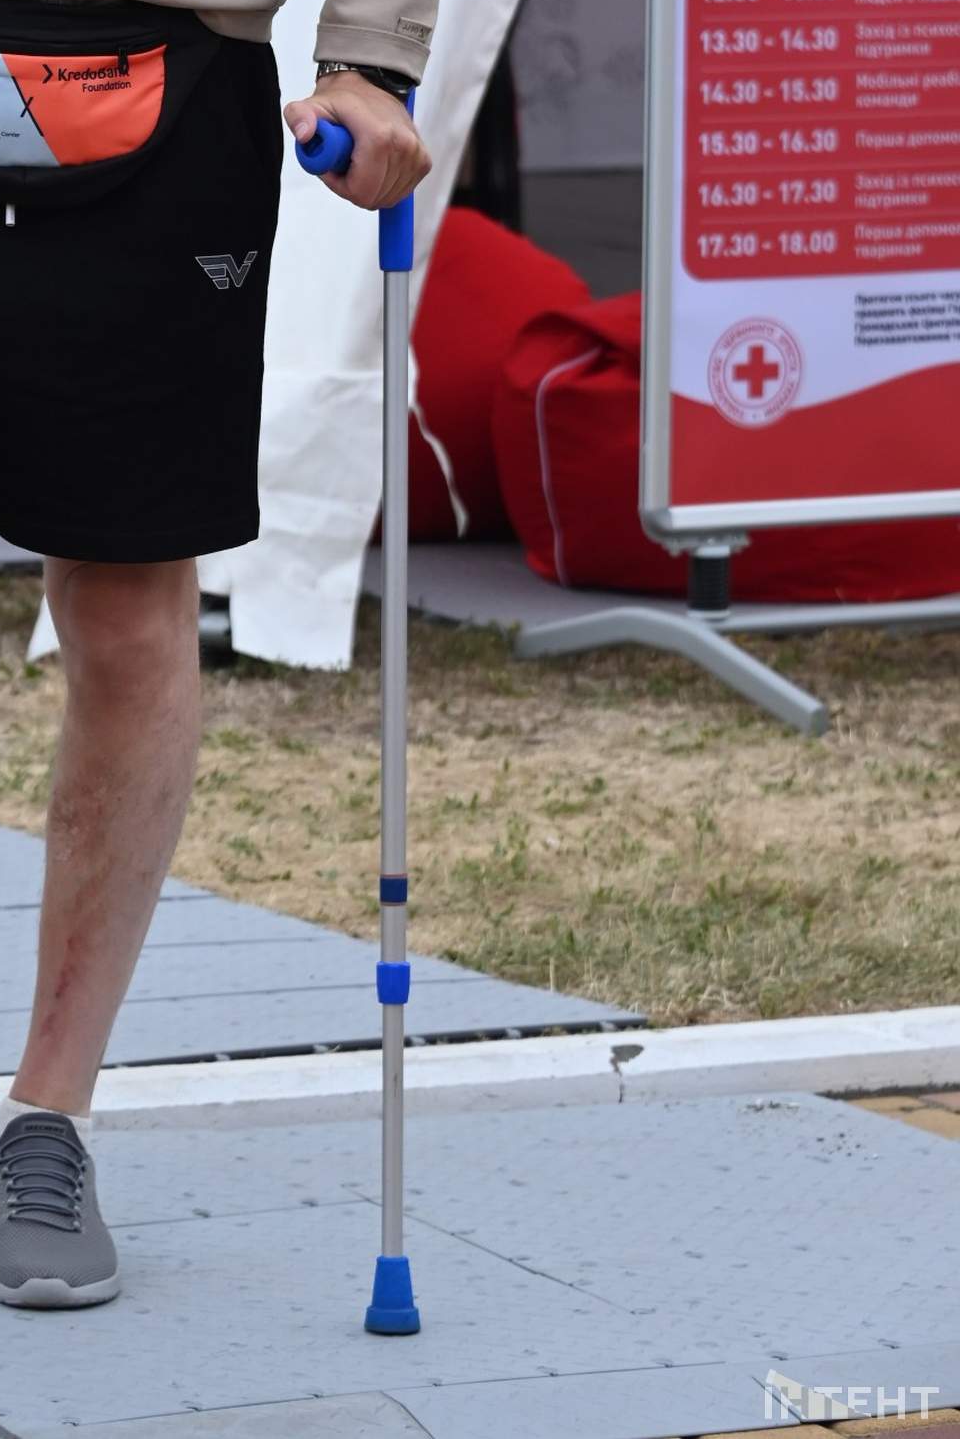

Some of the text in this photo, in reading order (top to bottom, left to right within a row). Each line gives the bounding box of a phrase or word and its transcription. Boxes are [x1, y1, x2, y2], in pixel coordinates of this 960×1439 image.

[700, 29, 759, 53] 13.30
[780, 28, 838, 51] 14.30
[82, 81, 132, 93] Foundation
[700, 80, 758, 104] 14.30
[780, 78, 838, 102] 15.30
[699, 131, 759, 155] 15.30
[780, 129, 838, 153] 16.30
[699, 182, 759, 207] 16.30
[779, 180, 838, 204] 17.30
[698, 234, 758, 258] 17.30
[779, 232, 838, 255] 18.00
